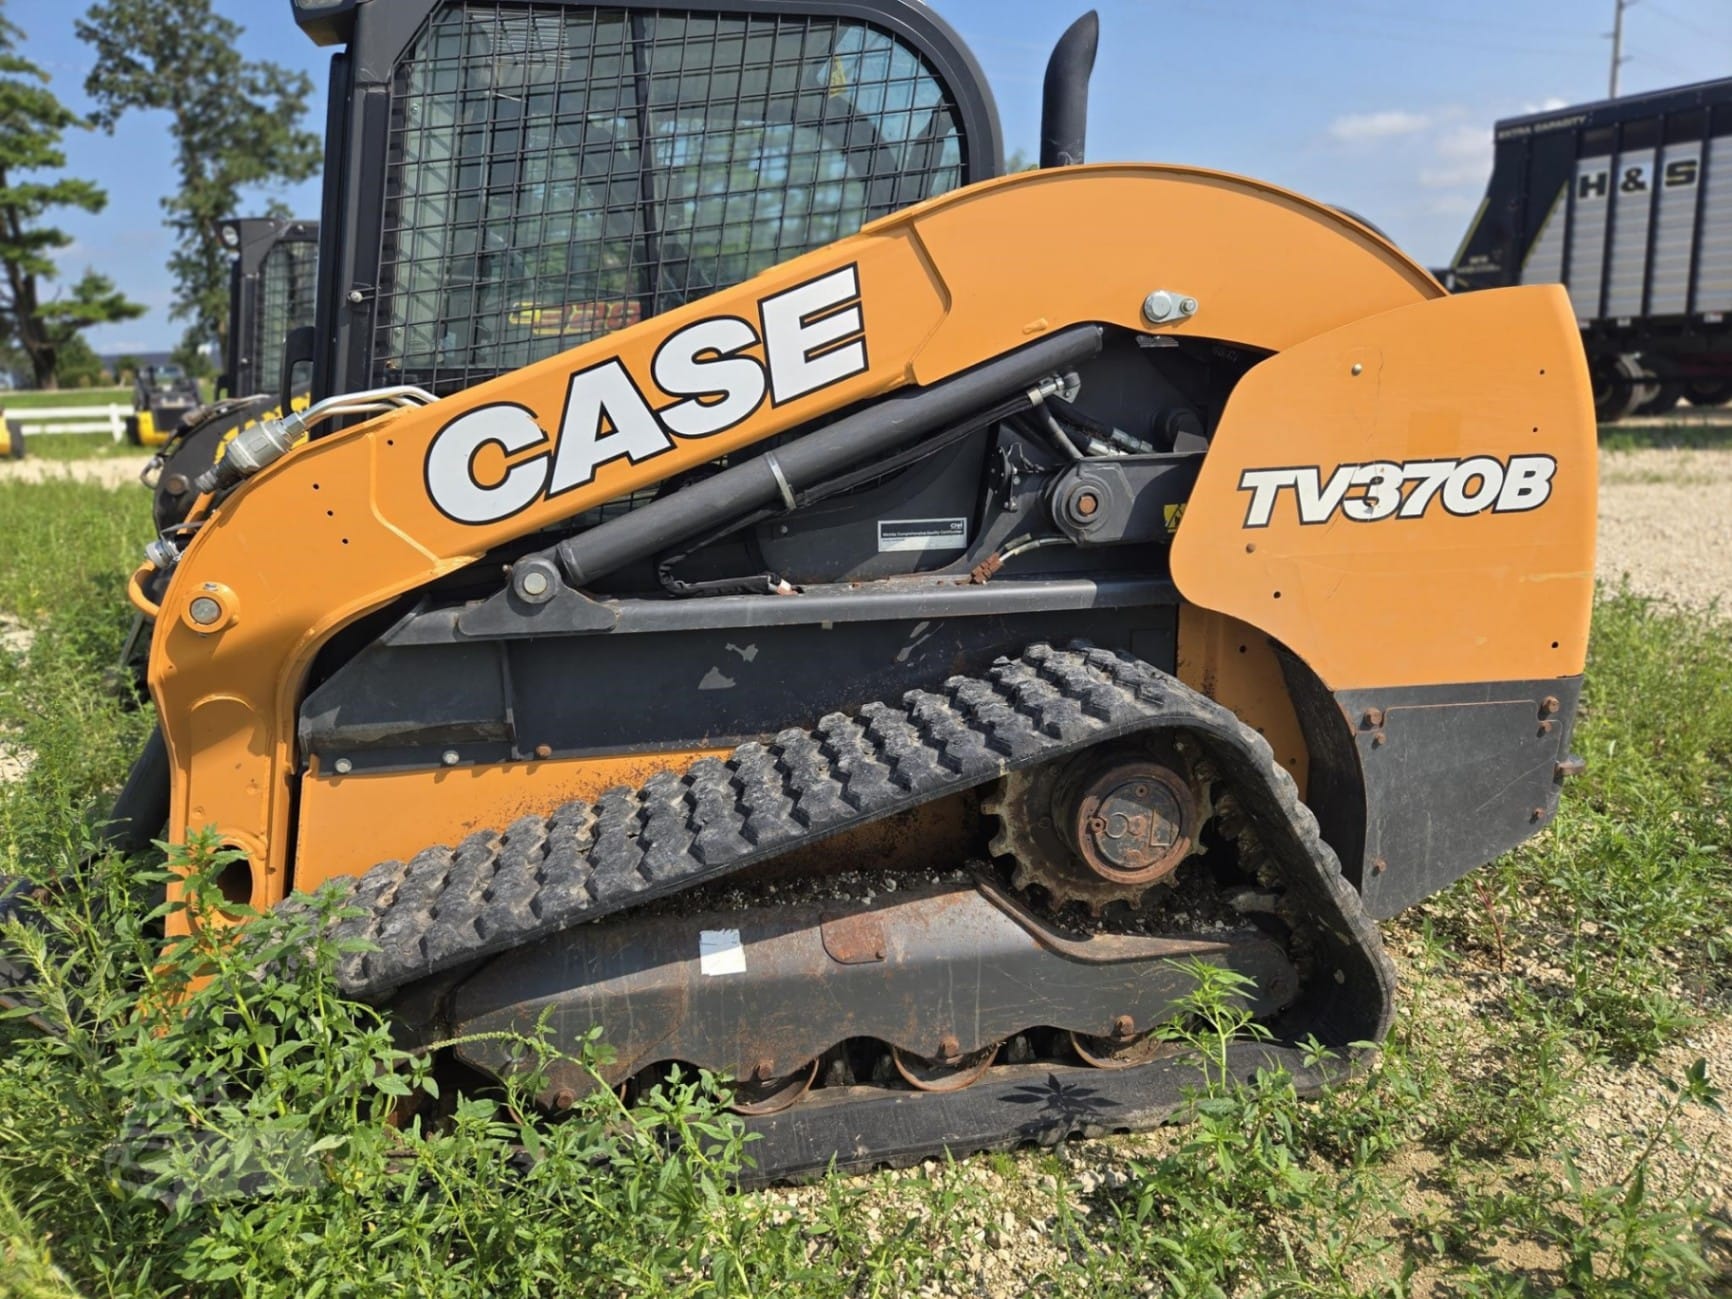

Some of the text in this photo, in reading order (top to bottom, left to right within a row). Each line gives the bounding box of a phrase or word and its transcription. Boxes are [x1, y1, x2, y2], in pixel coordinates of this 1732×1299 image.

[1533, 115, 1587, 133] CAPACITY
[1579, 159, 1698, 199] H & S
[423, 261, 869, 526] CASE
[1237, 453, 1557, 529] TV370B
